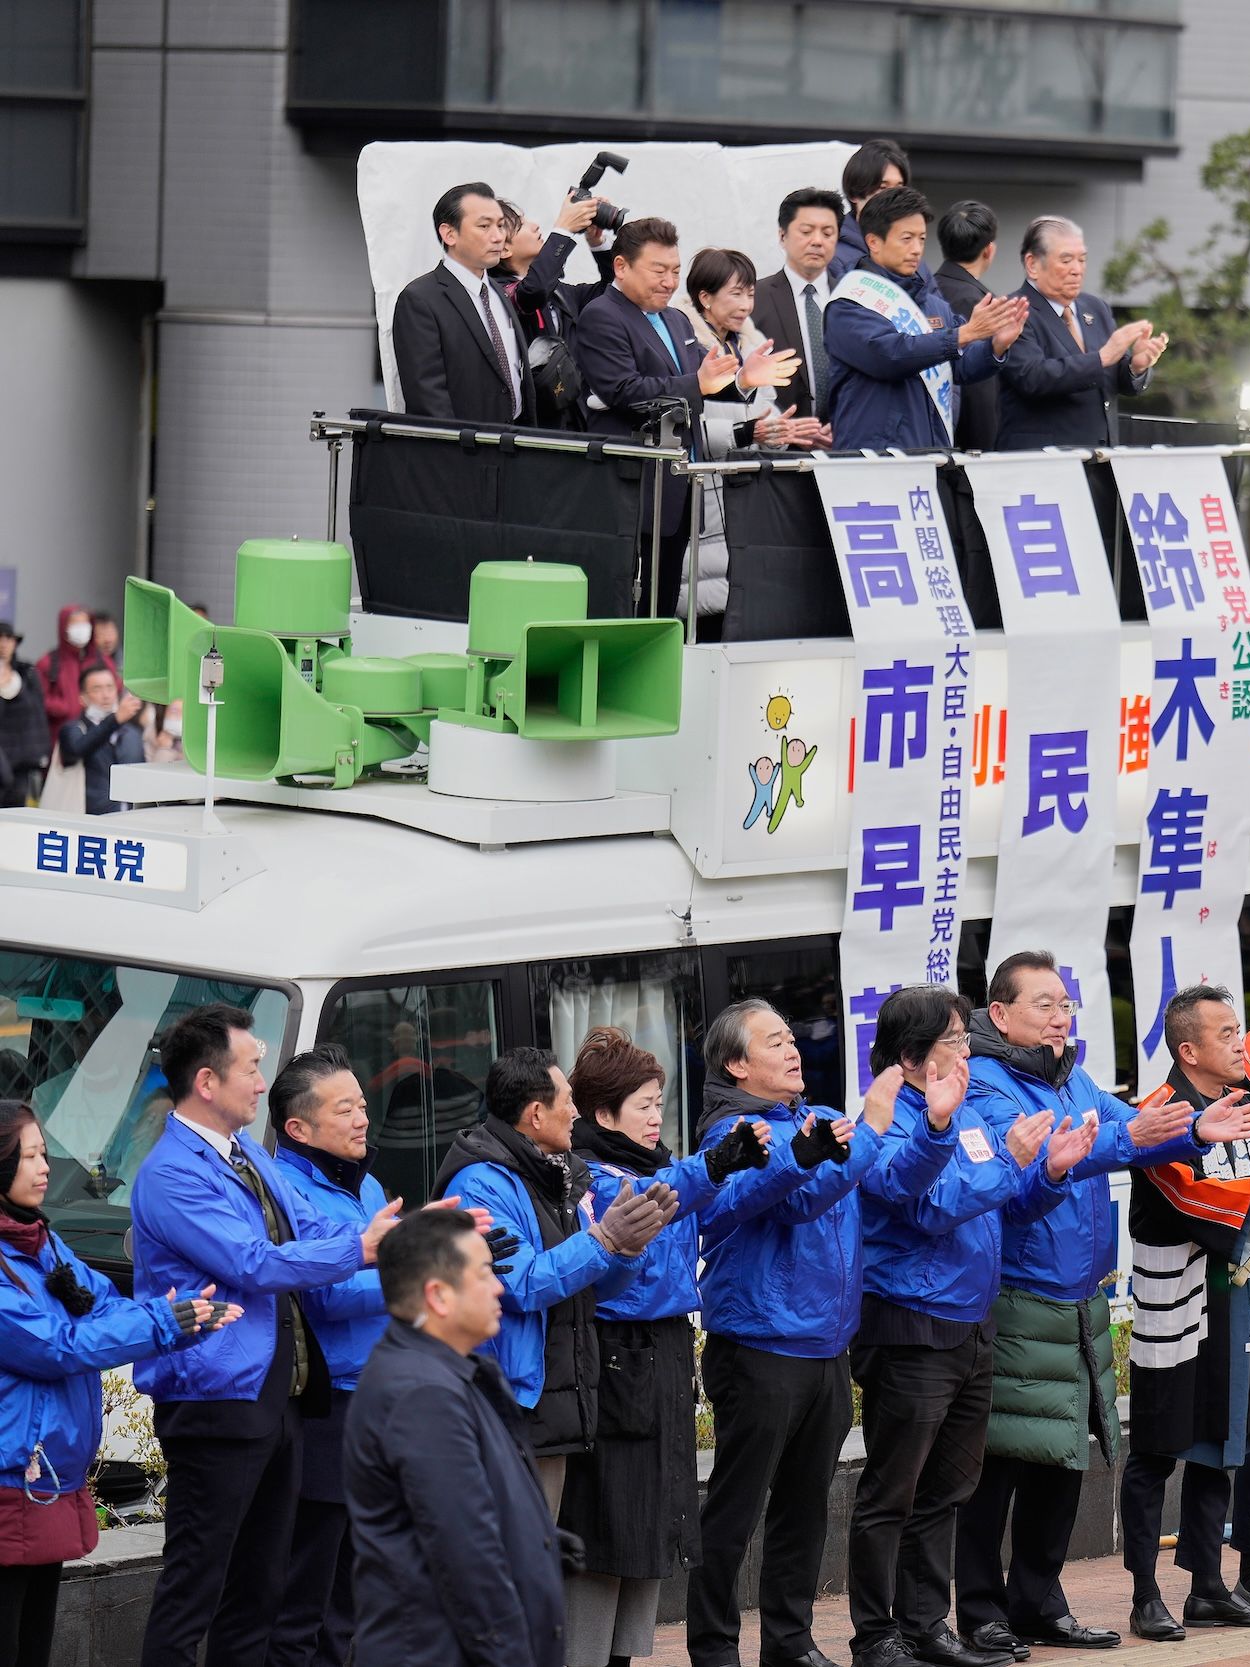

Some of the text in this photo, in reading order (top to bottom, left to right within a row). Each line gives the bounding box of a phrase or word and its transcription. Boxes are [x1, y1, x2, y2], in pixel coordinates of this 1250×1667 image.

[37, 830, 145, 882] 自民党
[1003, 494, 1089, 1066] 自民
